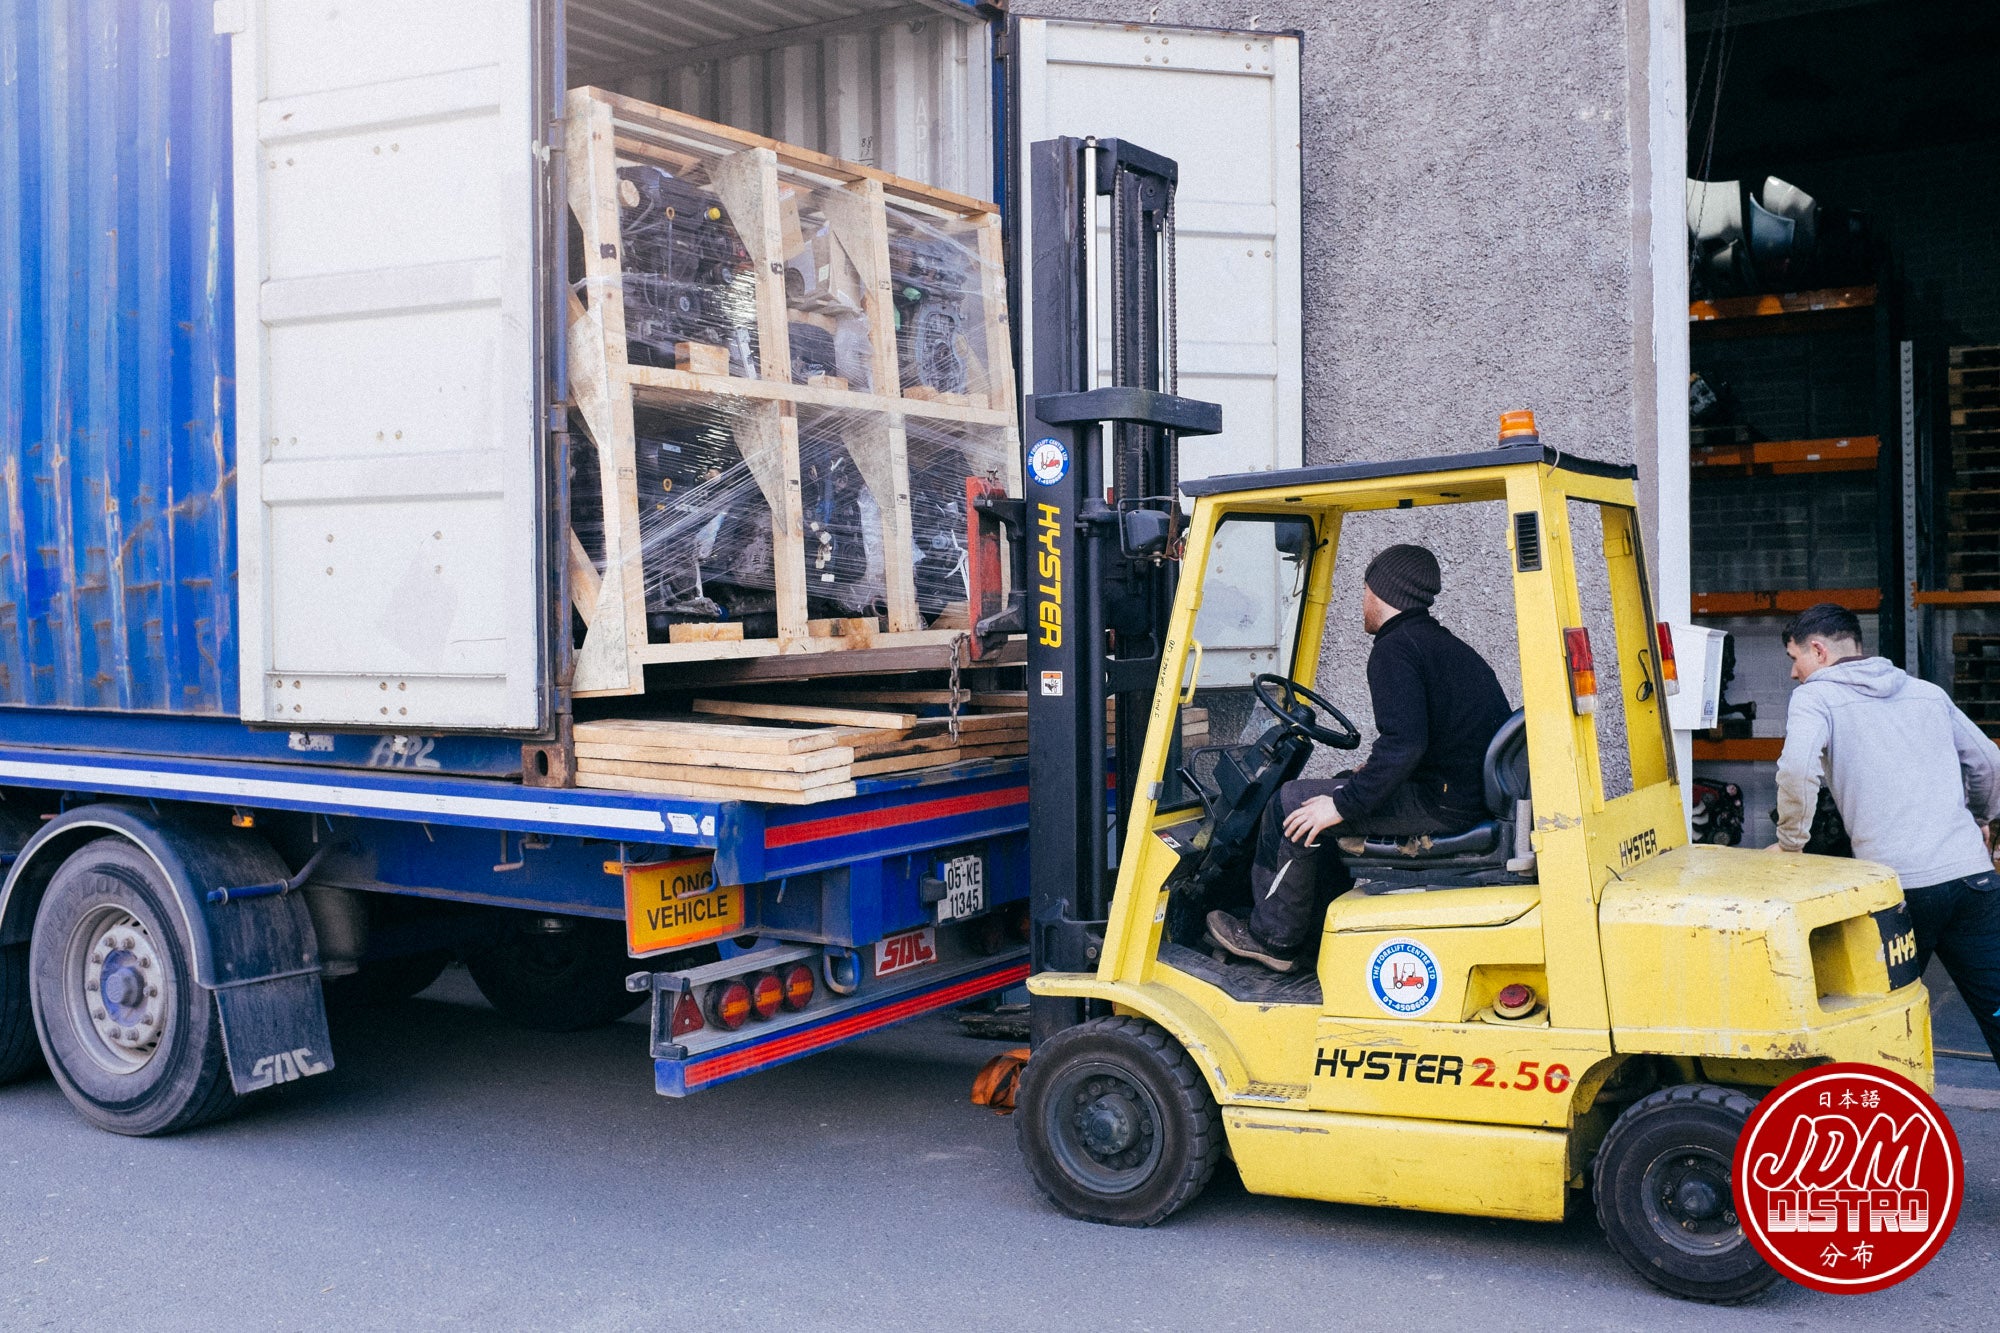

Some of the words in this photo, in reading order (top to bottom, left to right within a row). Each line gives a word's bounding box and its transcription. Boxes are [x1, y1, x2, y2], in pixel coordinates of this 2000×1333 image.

[1037, 502, 1062, 649] HYSTER
[1619, 828, 1658, 868] HYSTER
[947, 861, 980, 890] 05-KE
[646, 894, 728, 931] VEHICLE
[949, 888, 979, 917] 11345
[1376, 944, 1405, 964] FORKLIFT
[1406, 945, 1430, 966] CENTRE
[1372, 965, 1381, 980] THE
[1427, 965, 1436, 980] LTD
[1382, 995, 1429, 1012] 01-4508600
[1314, 1047, 1464, 1086] HYSTER
[1470, 1057, 1572, 1094] 2.50
